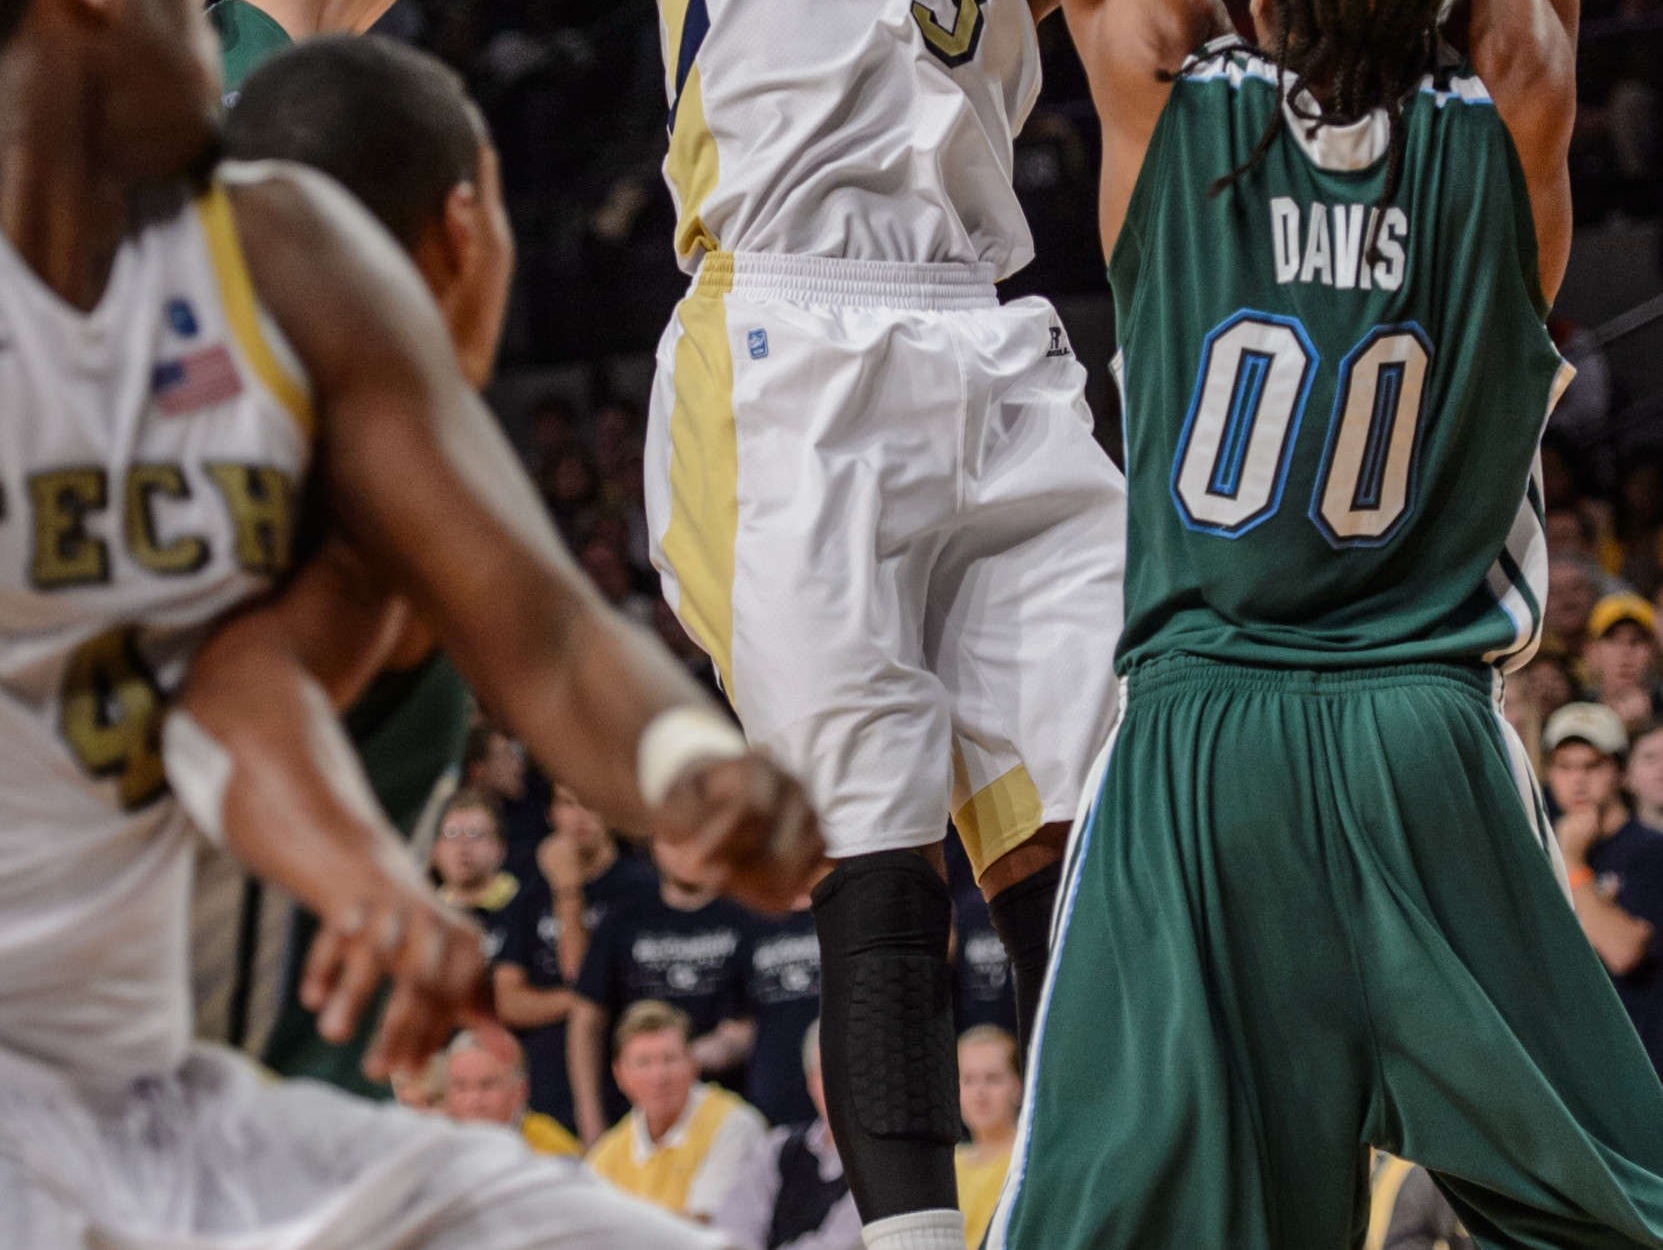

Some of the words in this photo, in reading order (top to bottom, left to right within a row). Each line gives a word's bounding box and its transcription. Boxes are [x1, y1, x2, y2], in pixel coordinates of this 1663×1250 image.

[1270, 196, 1408, 291] DAVIS
[1169, 306, 1436, 550] 00
[0, 461, 300, 590] ECH
